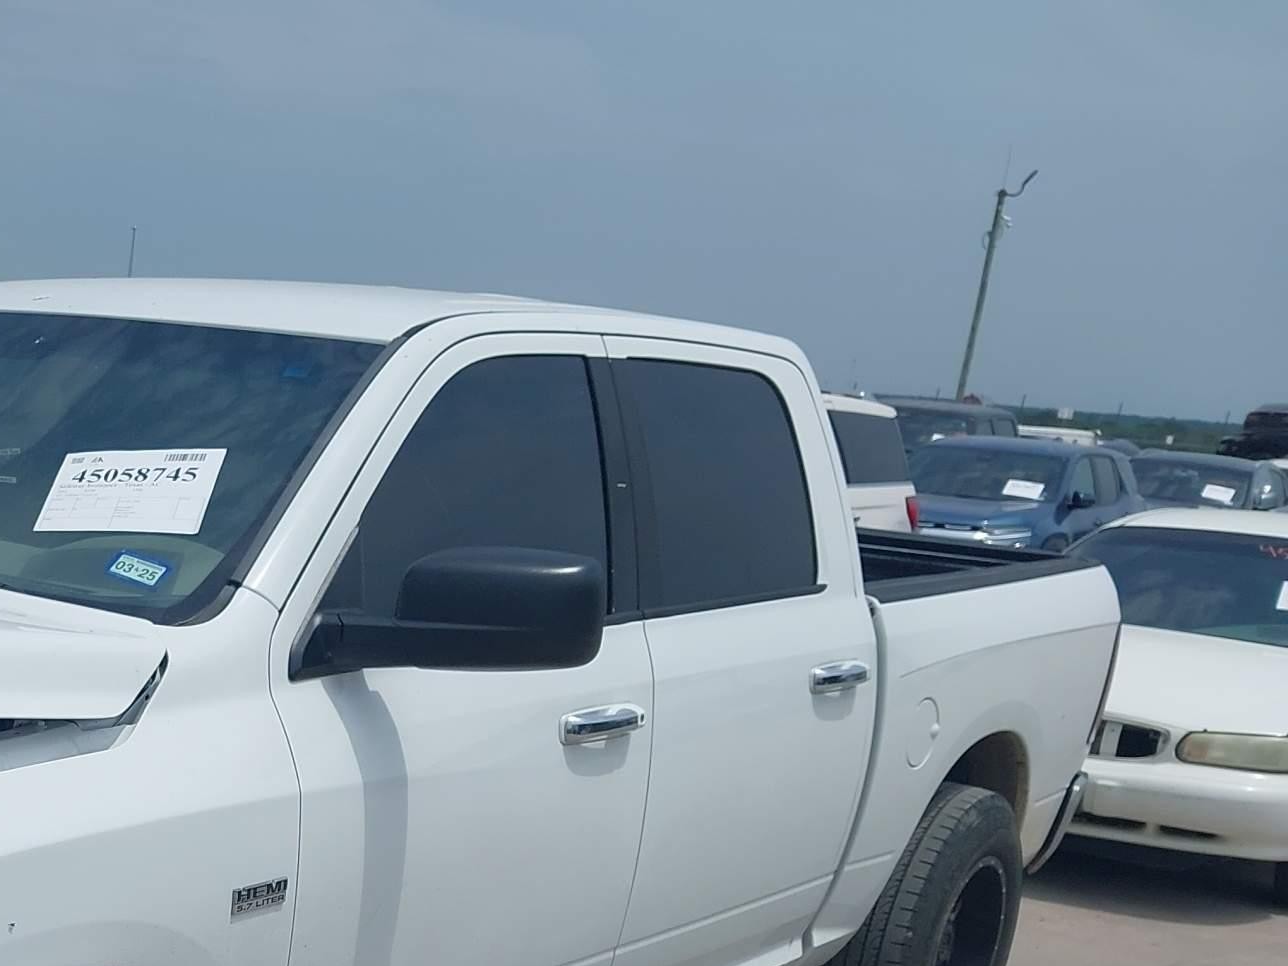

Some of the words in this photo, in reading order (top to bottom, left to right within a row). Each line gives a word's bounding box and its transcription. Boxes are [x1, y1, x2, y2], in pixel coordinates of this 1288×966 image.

[72, 467, 199, 483] 45058745
[115, 560, 134, 573] 03
[137, 568, 159, 581] 25
[235, 879, 288, 903] HEMI
[236, 902, 253, 912] 5.7
[255, 894, 285, 907] LITER
